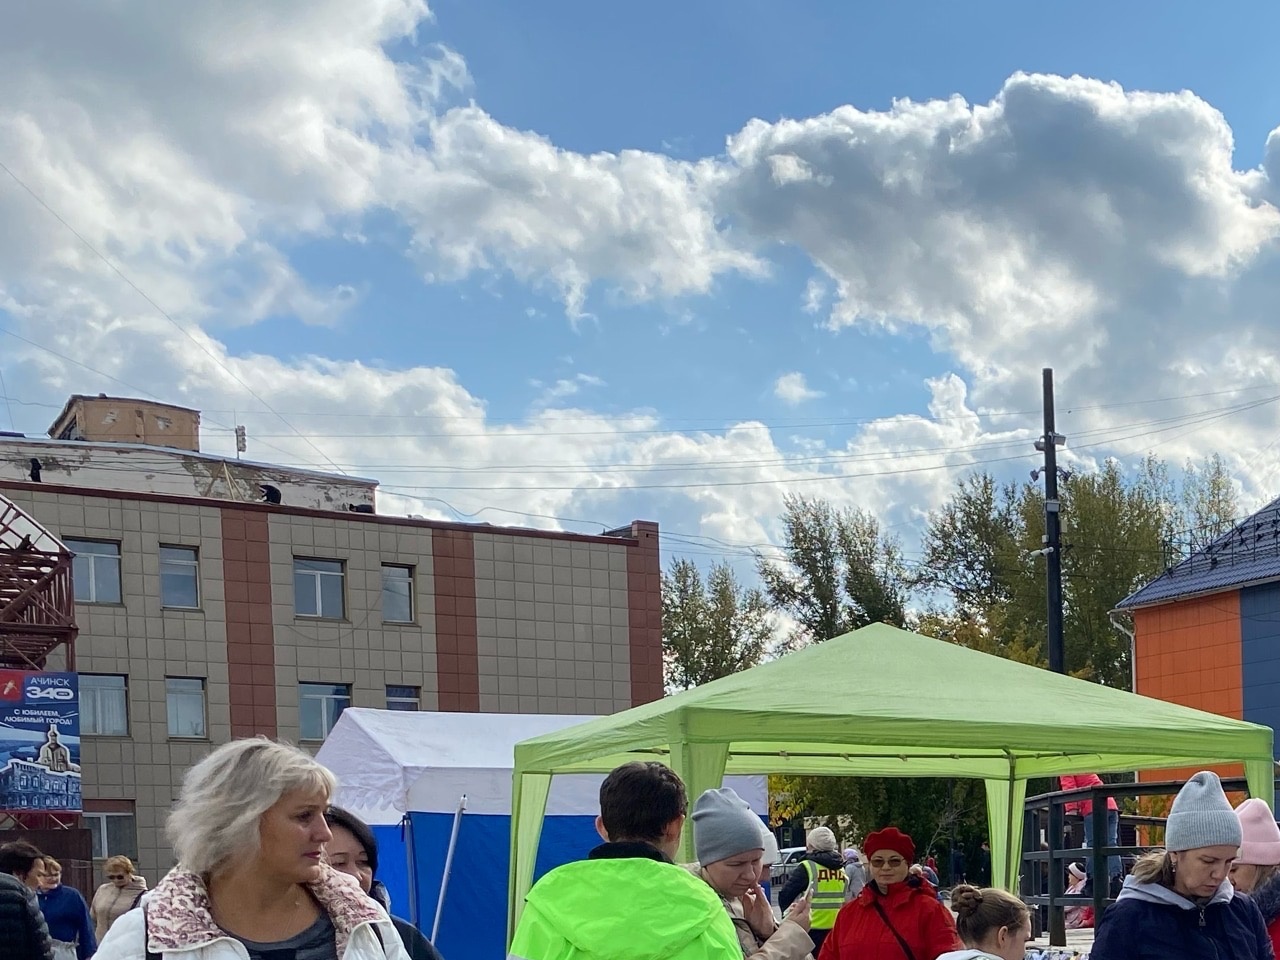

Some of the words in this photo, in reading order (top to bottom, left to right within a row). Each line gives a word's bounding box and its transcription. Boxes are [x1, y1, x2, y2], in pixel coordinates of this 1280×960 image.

[30, 677, 70, 687] АЧИНСК
[26, 686, 74, 700] 340
[45, 717, 73, 725] ГОРОД!
